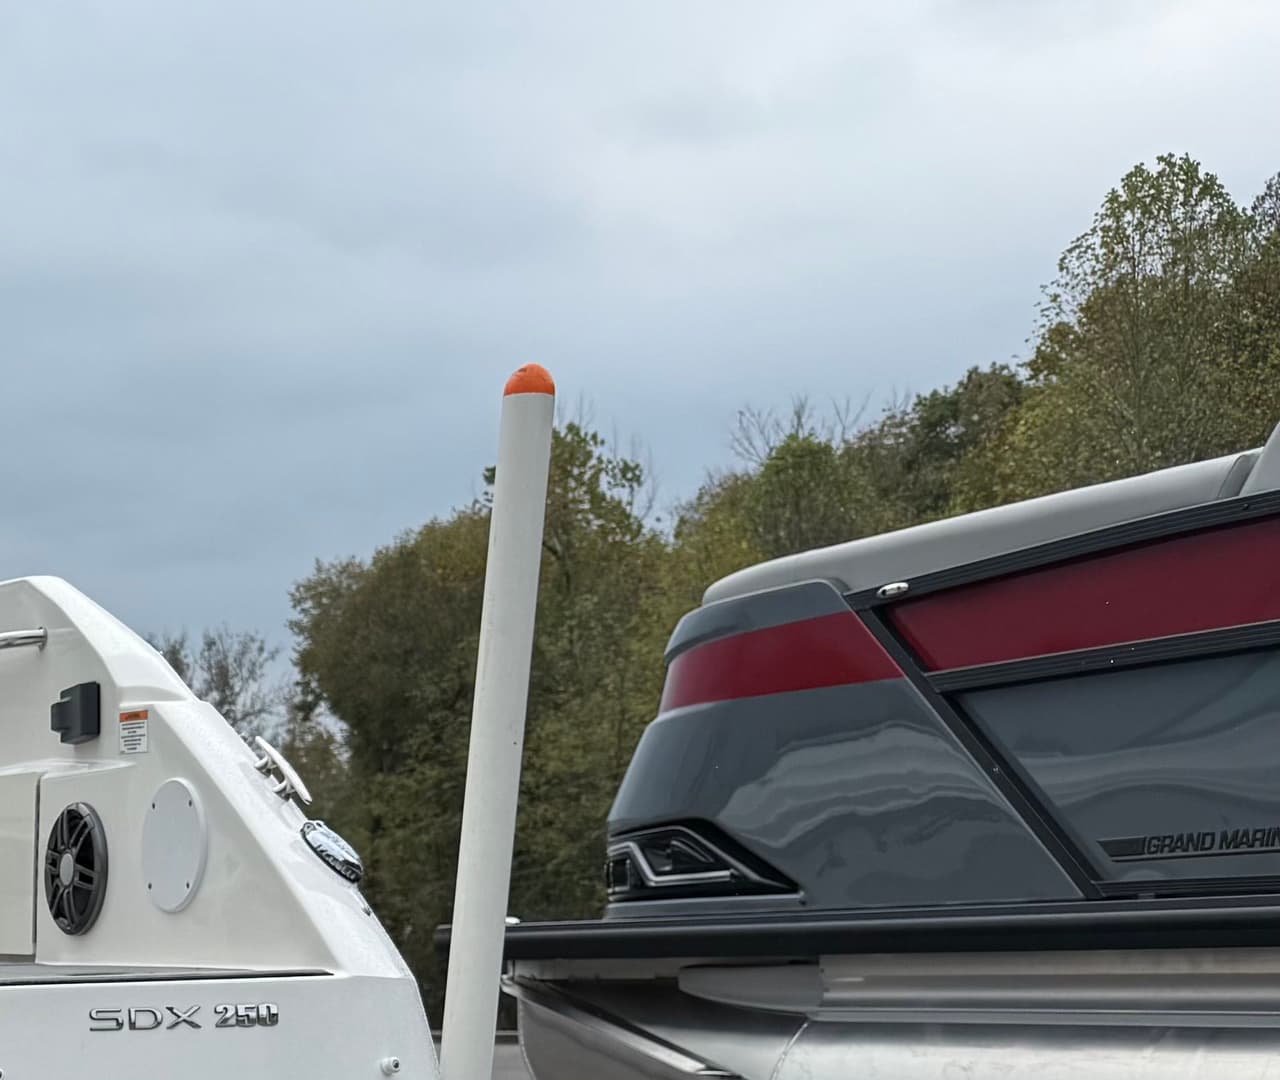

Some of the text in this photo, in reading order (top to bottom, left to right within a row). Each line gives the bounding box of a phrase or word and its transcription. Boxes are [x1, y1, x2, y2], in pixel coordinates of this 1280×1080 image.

[1146, 832, 1216, 855] GRAND
[89, 1003, 279, 1032] SDX 250
